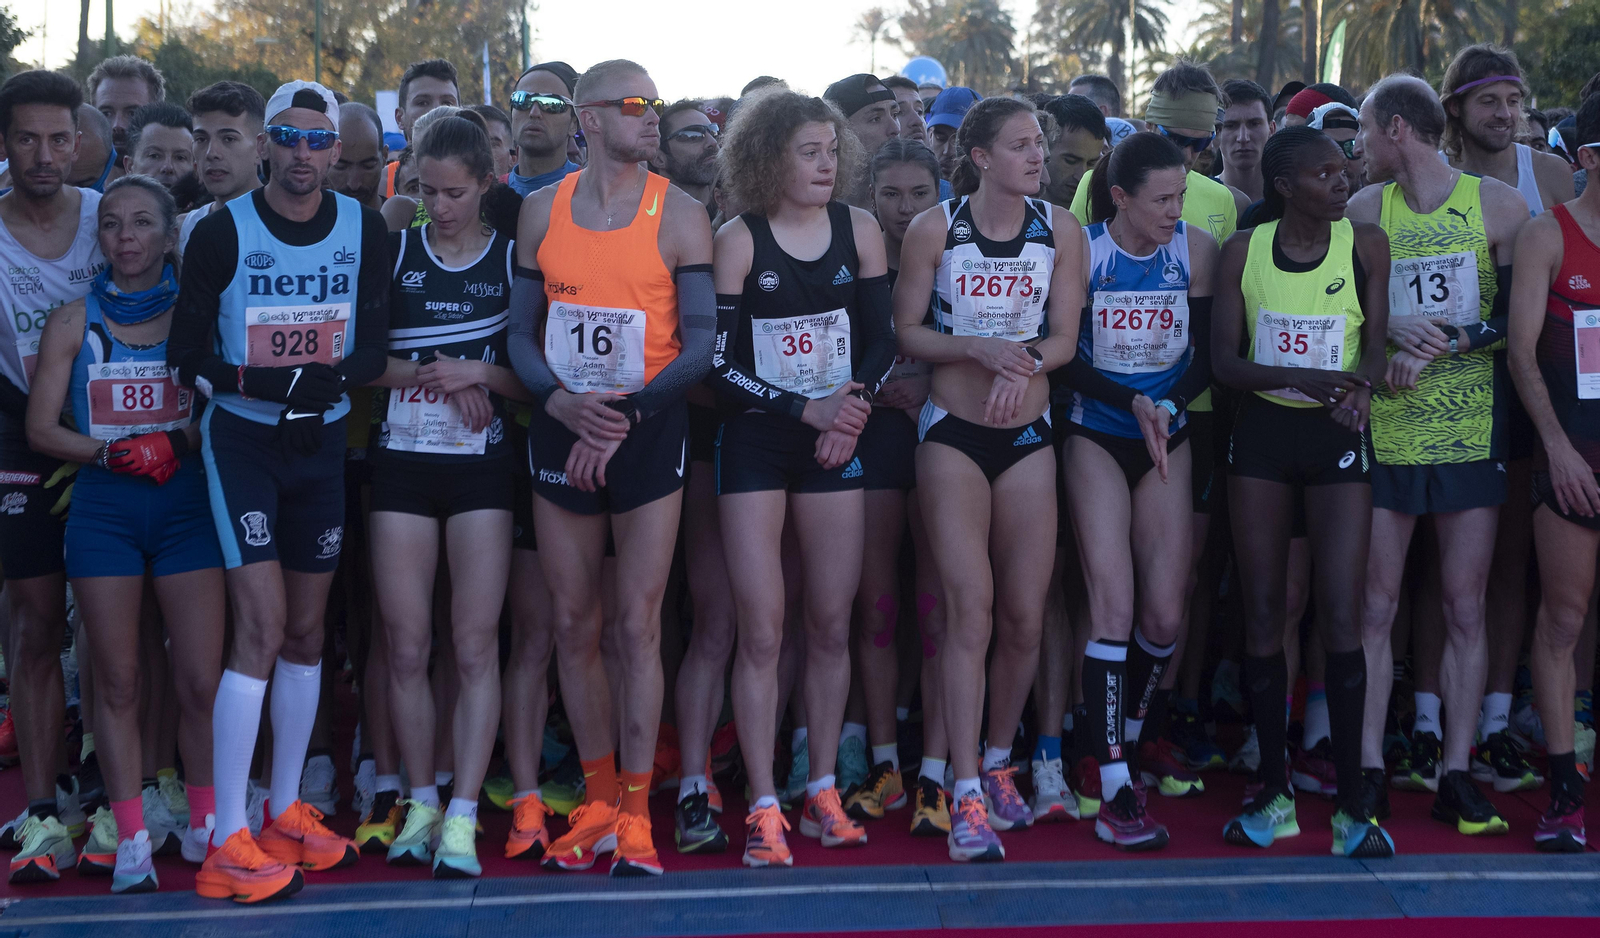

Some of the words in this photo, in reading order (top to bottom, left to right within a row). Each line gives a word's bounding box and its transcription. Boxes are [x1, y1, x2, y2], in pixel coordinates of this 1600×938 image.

[1025, 229, 1048, 239] adidas
[245, 254, 274, 267] TROPS
[68, 263, 105, 281] JULIÁN
[974, 261, 991, 272] edp
[1404, 262, 1419, 273] edp
[248, 265, 350, 303] nerja
[832, 275, 854, 286] adidas
[955, 274, 1034, 297] 12673
[11, 283, 45, 296] TEAM
[1409, 272, 1450, 305] 13
[1115, 295, 1132, 305] edp
[425, 301, 460, 311] SUPER
[462, 304, 471, 312] U
[271, 312, 290, 322] edp
[568, 309, 584, 320] edp
[1098, 308, 1174, 330] 12679
[774, 322, 792, 332] edp
[997, 319, 1012, 327] edp
[1273, 317, 1290, 328] edp
[271, 329, 319, 357] 928
[570, 323, 613, 356] 16
[714, 334, 722, 351] TEAM
[782, 333, 813, 356] 36
[1277, 331, 1308, 355] 35
[1113, 343, 1168, 351] Jacquot-Claude
[1137, 350, 1152, 358] edp
[112, 366, 131, 377] edp
[800, 368, 814, 376] Reh
[722, 368, 767, 397] TERREX
[122, 385, 154, 410] 88
[424, 419, 447, 427] Julien
[1013, 435, 1042, 447] adidas
[1106, 671, 1117, 745] COMPRESPORT
